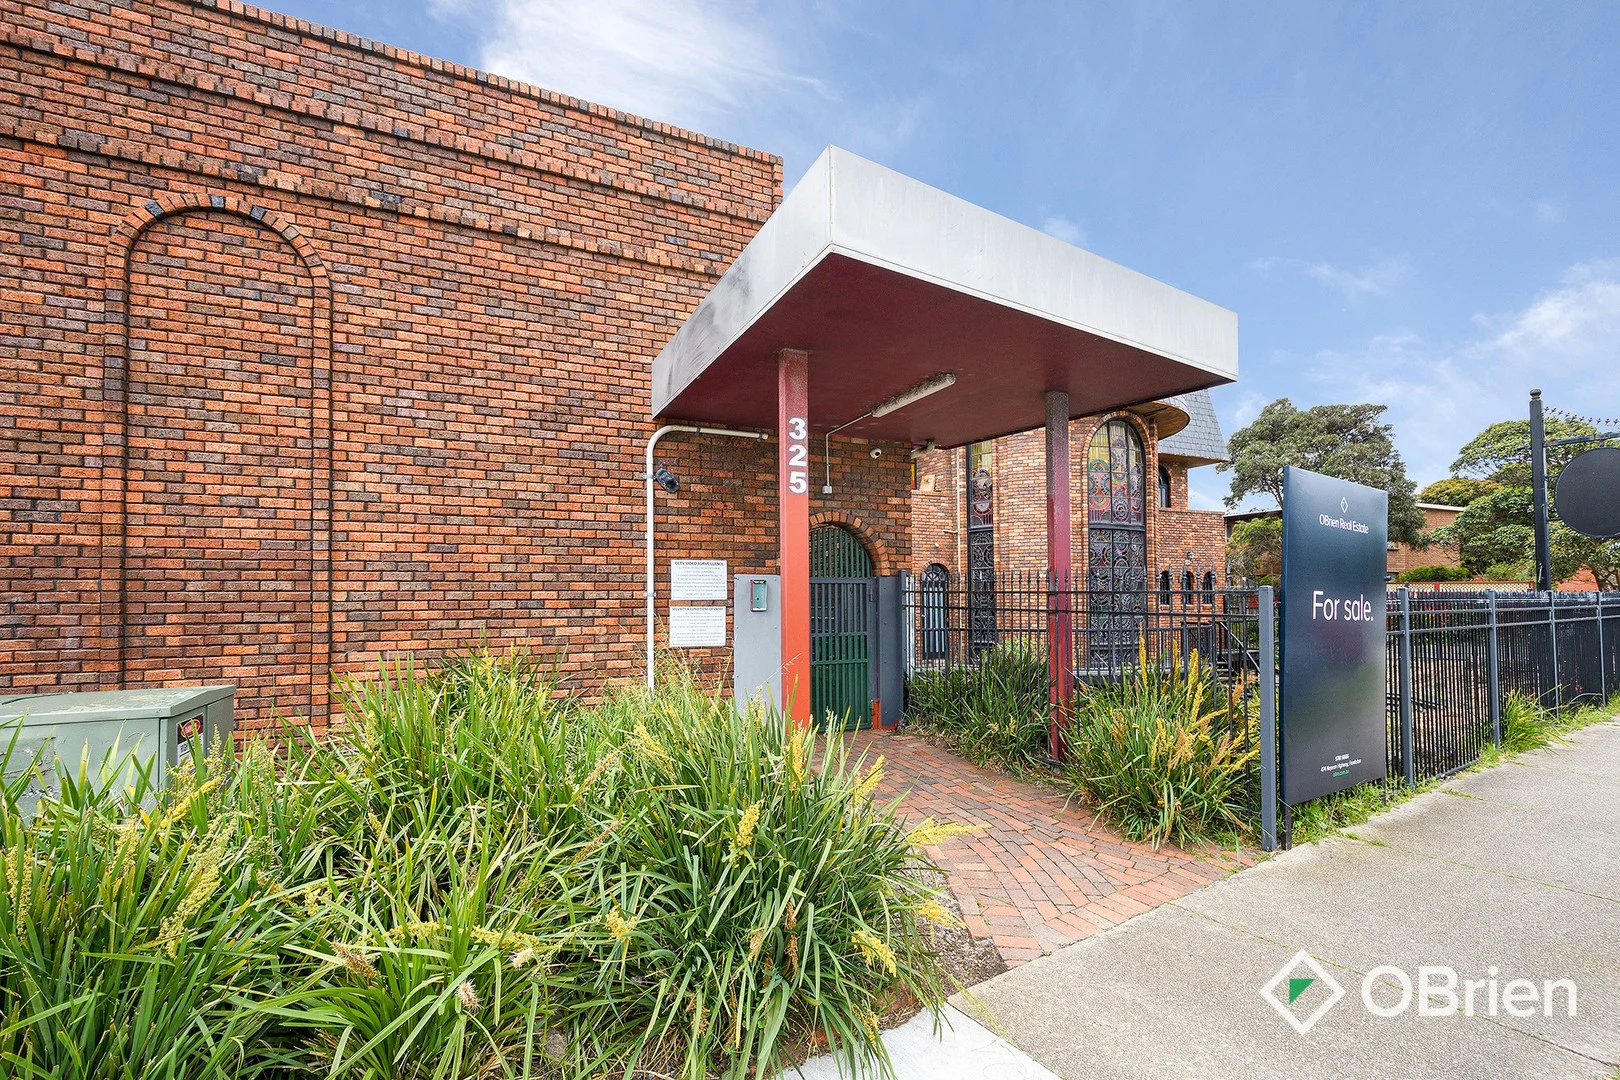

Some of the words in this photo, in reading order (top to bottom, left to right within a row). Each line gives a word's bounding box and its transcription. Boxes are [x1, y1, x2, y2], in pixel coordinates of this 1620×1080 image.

[788, 417, 807, 494] 325
[1319, 513, 1340, 528] OBrien
[1340, 518, 1352, 531] Real
[1352, 520, 1369, 534] Estate
[1312, 590, 1340, 621] For
[1343, 593, 1374, 622] sale.
